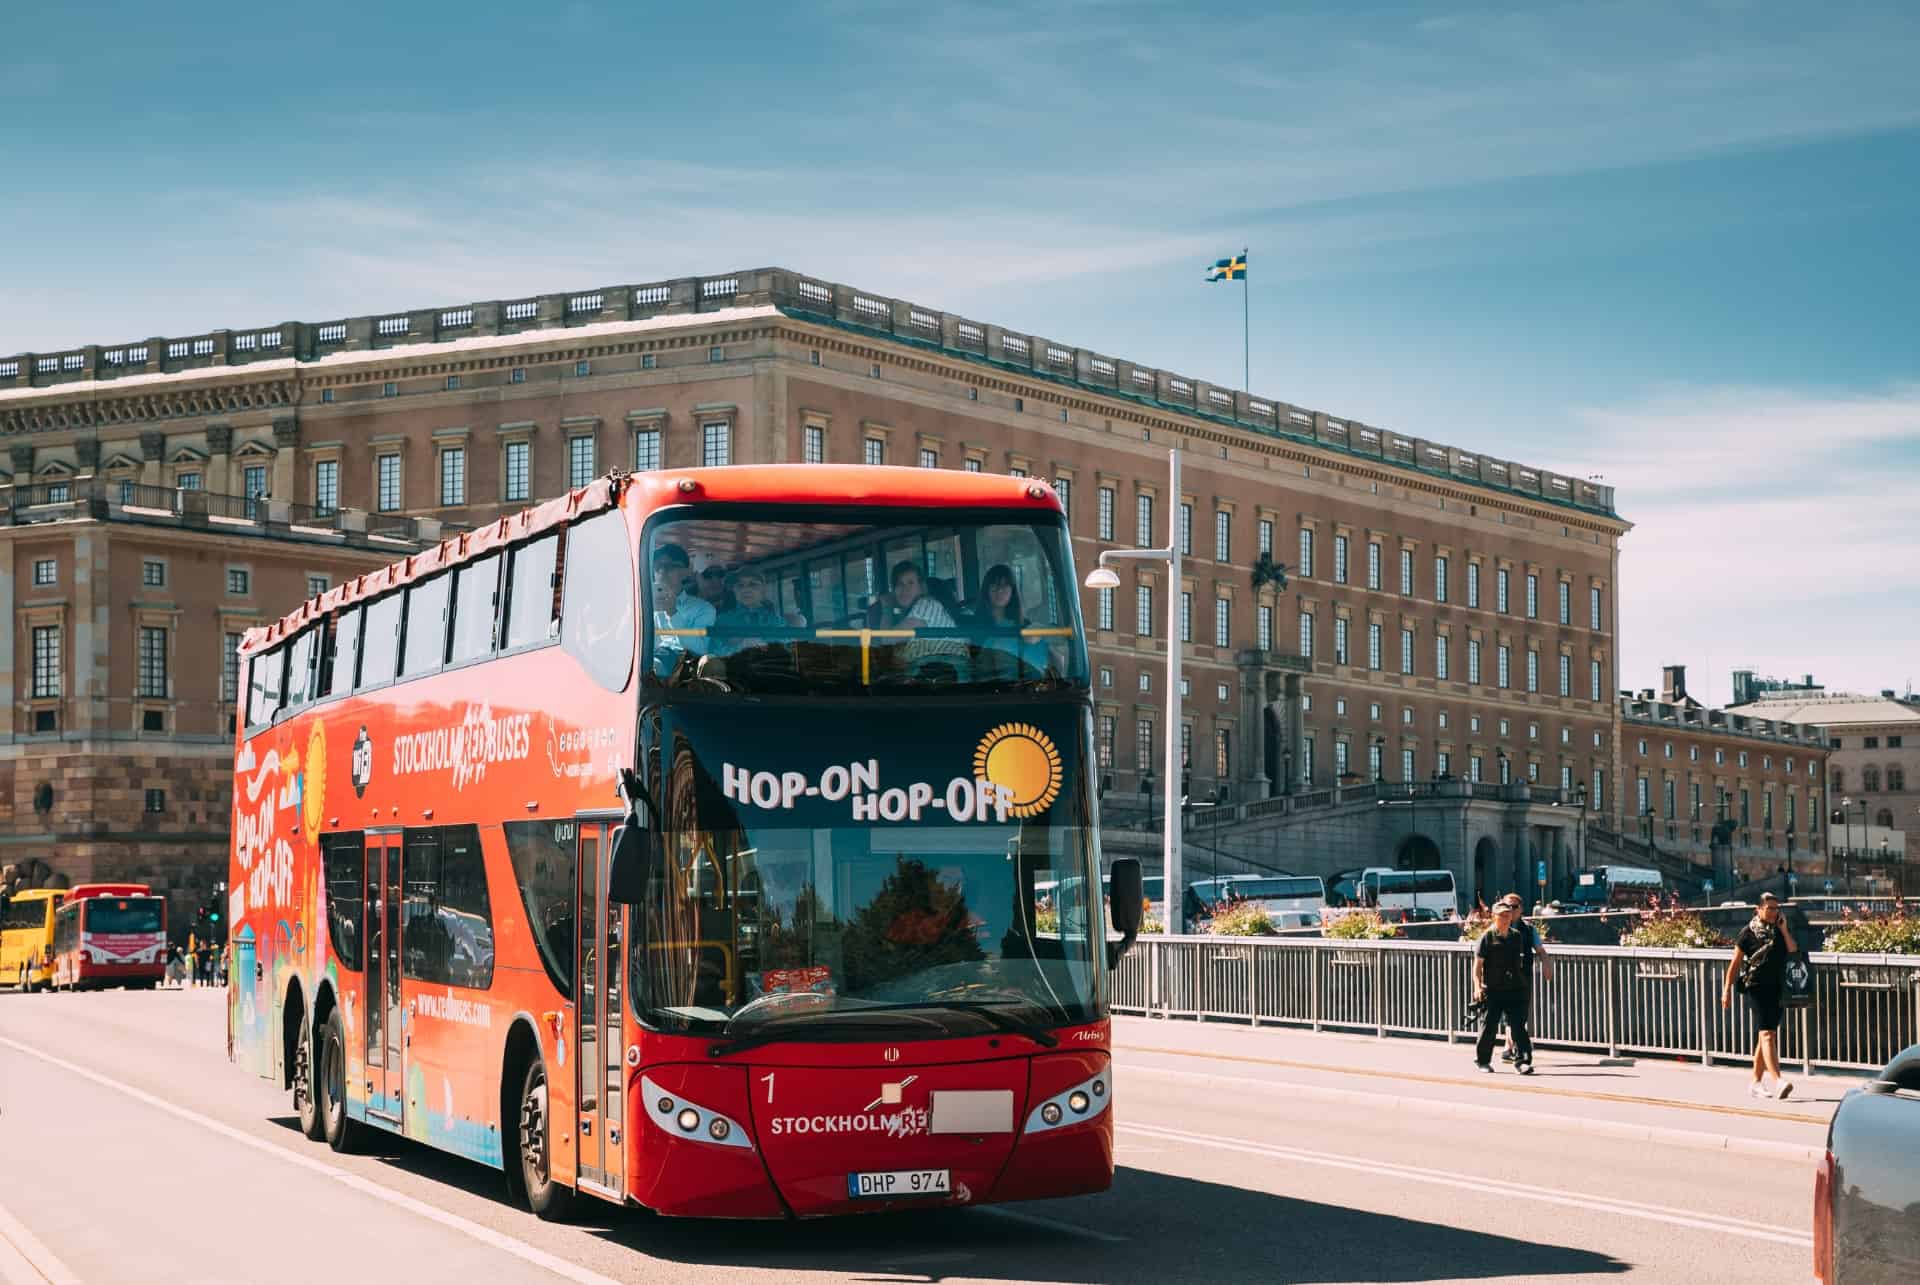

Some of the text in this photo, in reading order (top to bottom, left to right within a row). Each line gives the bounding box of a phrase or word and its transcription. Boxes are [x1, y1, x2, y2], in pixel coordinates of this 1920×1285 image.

[488, 714, 530, 762] BUSES
[723, 759, 879, 809] HOP-ON
[852, 777, 1014, 823] HOP-OFF
[236, 787, 275, 872] HOP-ON
[250, 838, 294, 909] HOP-OFF
[761, 1072, 775, 1104] 1
[861, 1172, 945, 1193] DHP 974
